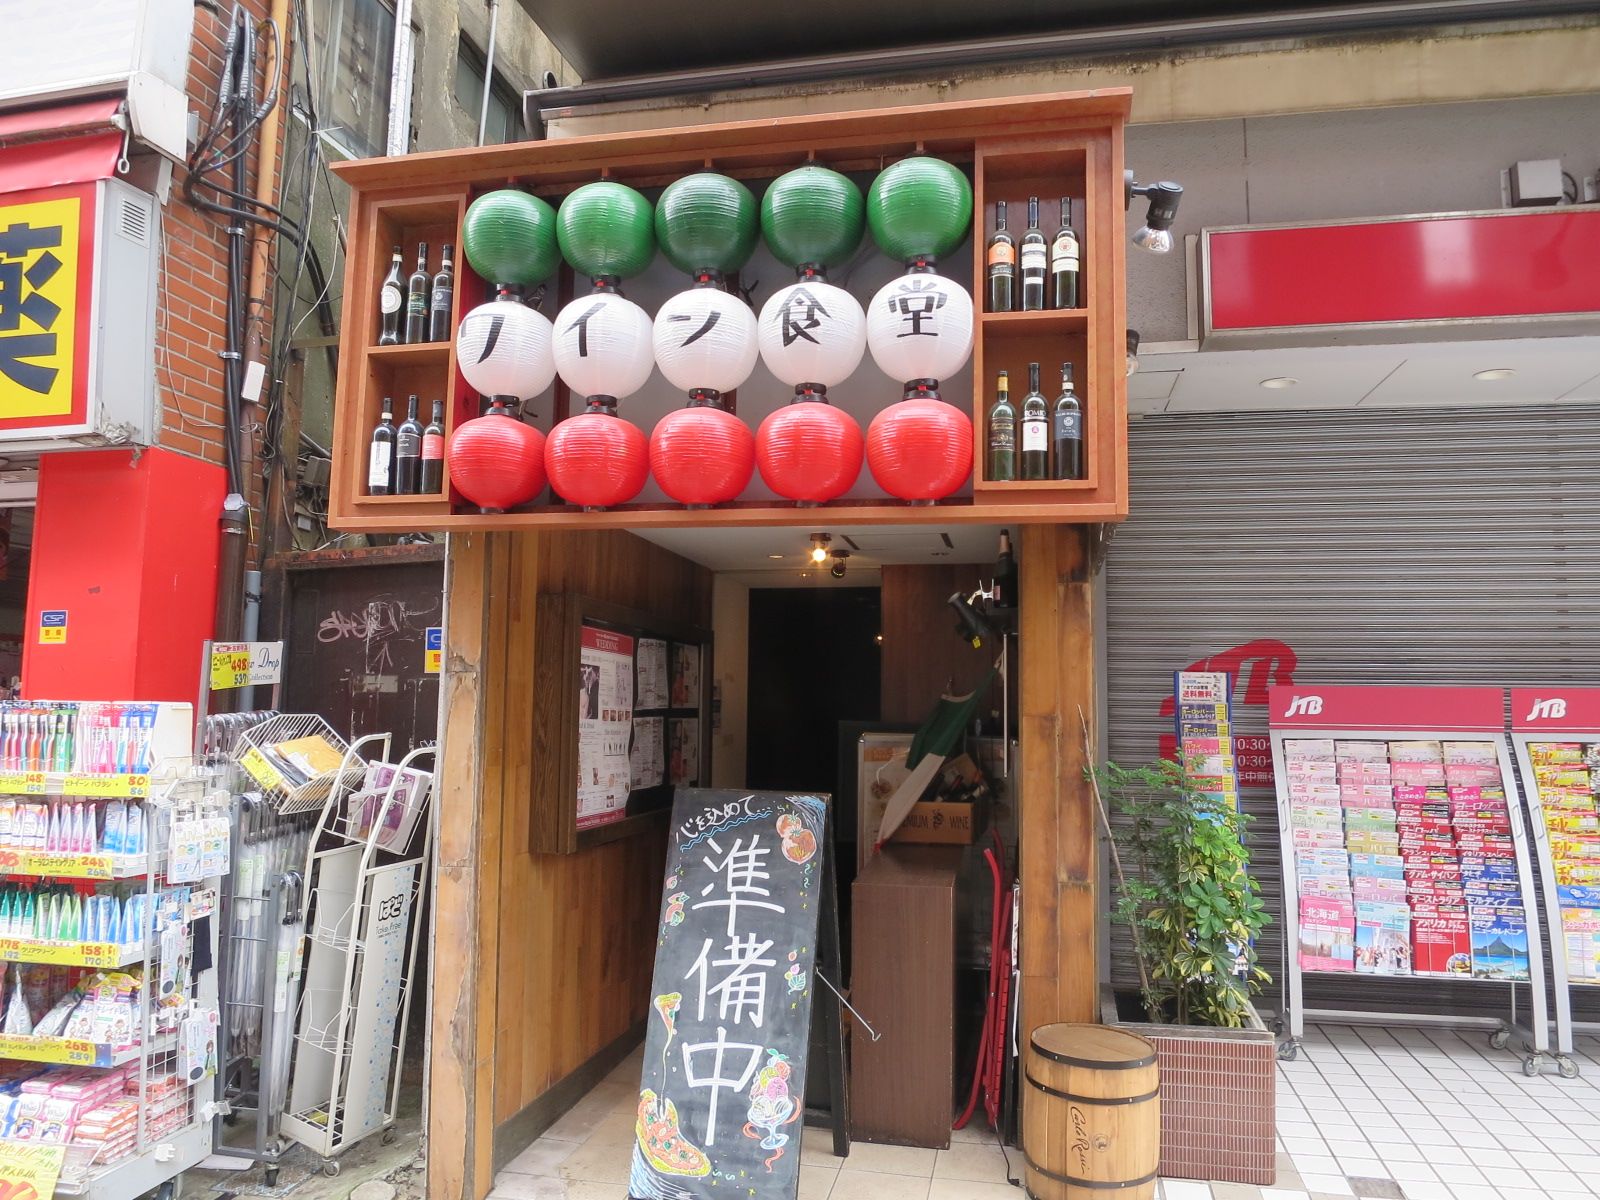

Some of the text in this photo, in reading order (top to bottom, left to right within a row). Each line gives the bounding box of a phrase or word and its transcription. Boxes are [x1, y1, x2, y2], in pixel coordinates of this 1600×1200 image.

[460, 278, 949, 364] ワイン食堂
[257, 646, 280, 671] Drop
[230, 657, 248, 672] 498
[233, 673, 247, 685] 537
[1182, 690, 1213, 698] 送料無料
[1285, 695, 1324, 718] JTB
[1526, 698, 1568, 721] JTB
[25, 773, 43, 784] 148
[128, 775, 146, 786] 80
[129, 787, 144, 796] 86
[949, 815, 970, 830] WINE
[1410, 895, 1461, 905] オーストラリア
[1305, 906, 1340, 920] 北海道
[1415, 919, 1447, 929] アメリカ
[1473, 927, 1525, 936] ニューカレドニア
[3, 950, 20, 959] 192
[80, 945, 102, 956] 158
[84, 957, 102, 966] 170
[681, 833, 785, 1147] 準備中
[64, 1040, 89, 1051] 268
[68, 1051, 90, 1061] 289
